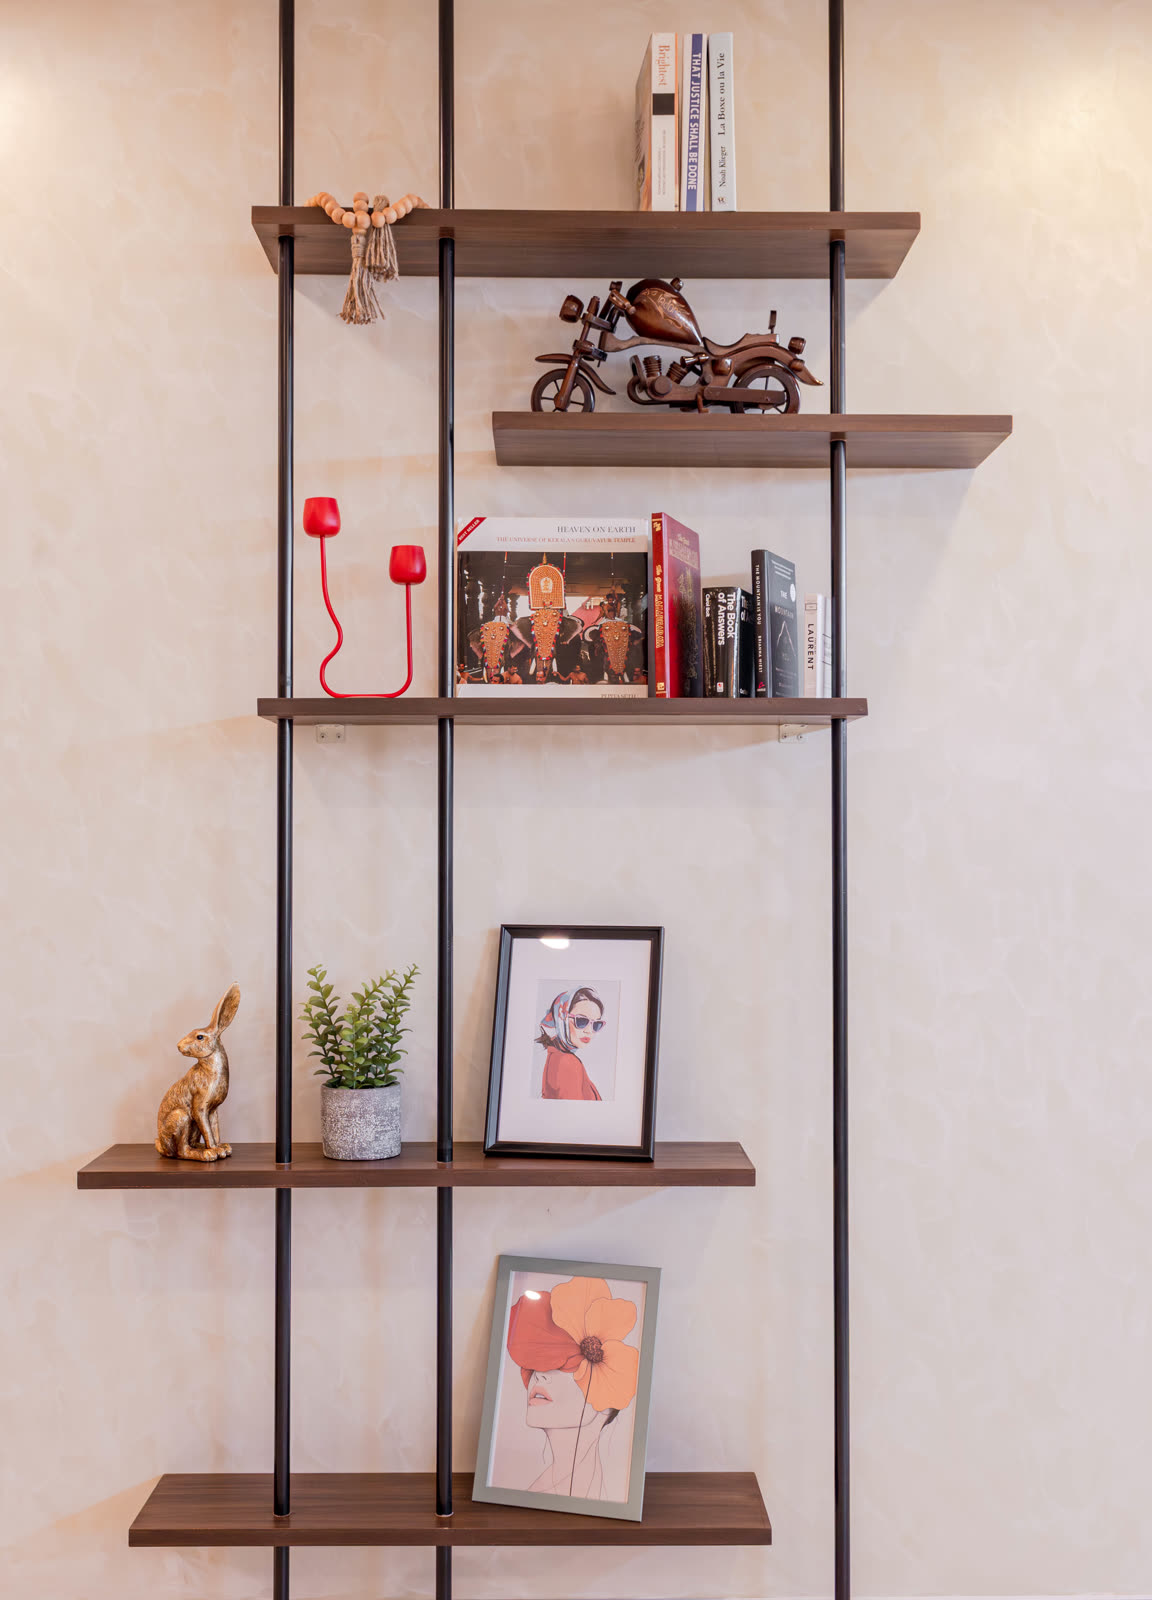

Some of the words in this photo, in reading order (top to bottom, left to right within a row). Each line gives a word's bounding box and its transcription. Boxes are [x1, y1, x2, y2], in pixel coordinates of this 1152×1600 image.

[658, 45, 670, 86] Brightest
[692, 52, 702, 78] THAT
[718, 71, 724, 80] la
[690, 80, 700, 120] JUSTICE
[720, 82, 725, 95] ou
[718, 97, 726, 122] Boxe
[689, 122, 699, 150] SHALL
[718, 123, 726, 136] La
[688, 152, 698, 162] BE
[719, 146, 727, 168] Klieger
[688, 165, 698, 190] DONE
[718, 592, 726, 604] of
[727, 592, 736, 610] The
[718, 604, 726, 646] Answers
[727, 612, 736, 638] Book
